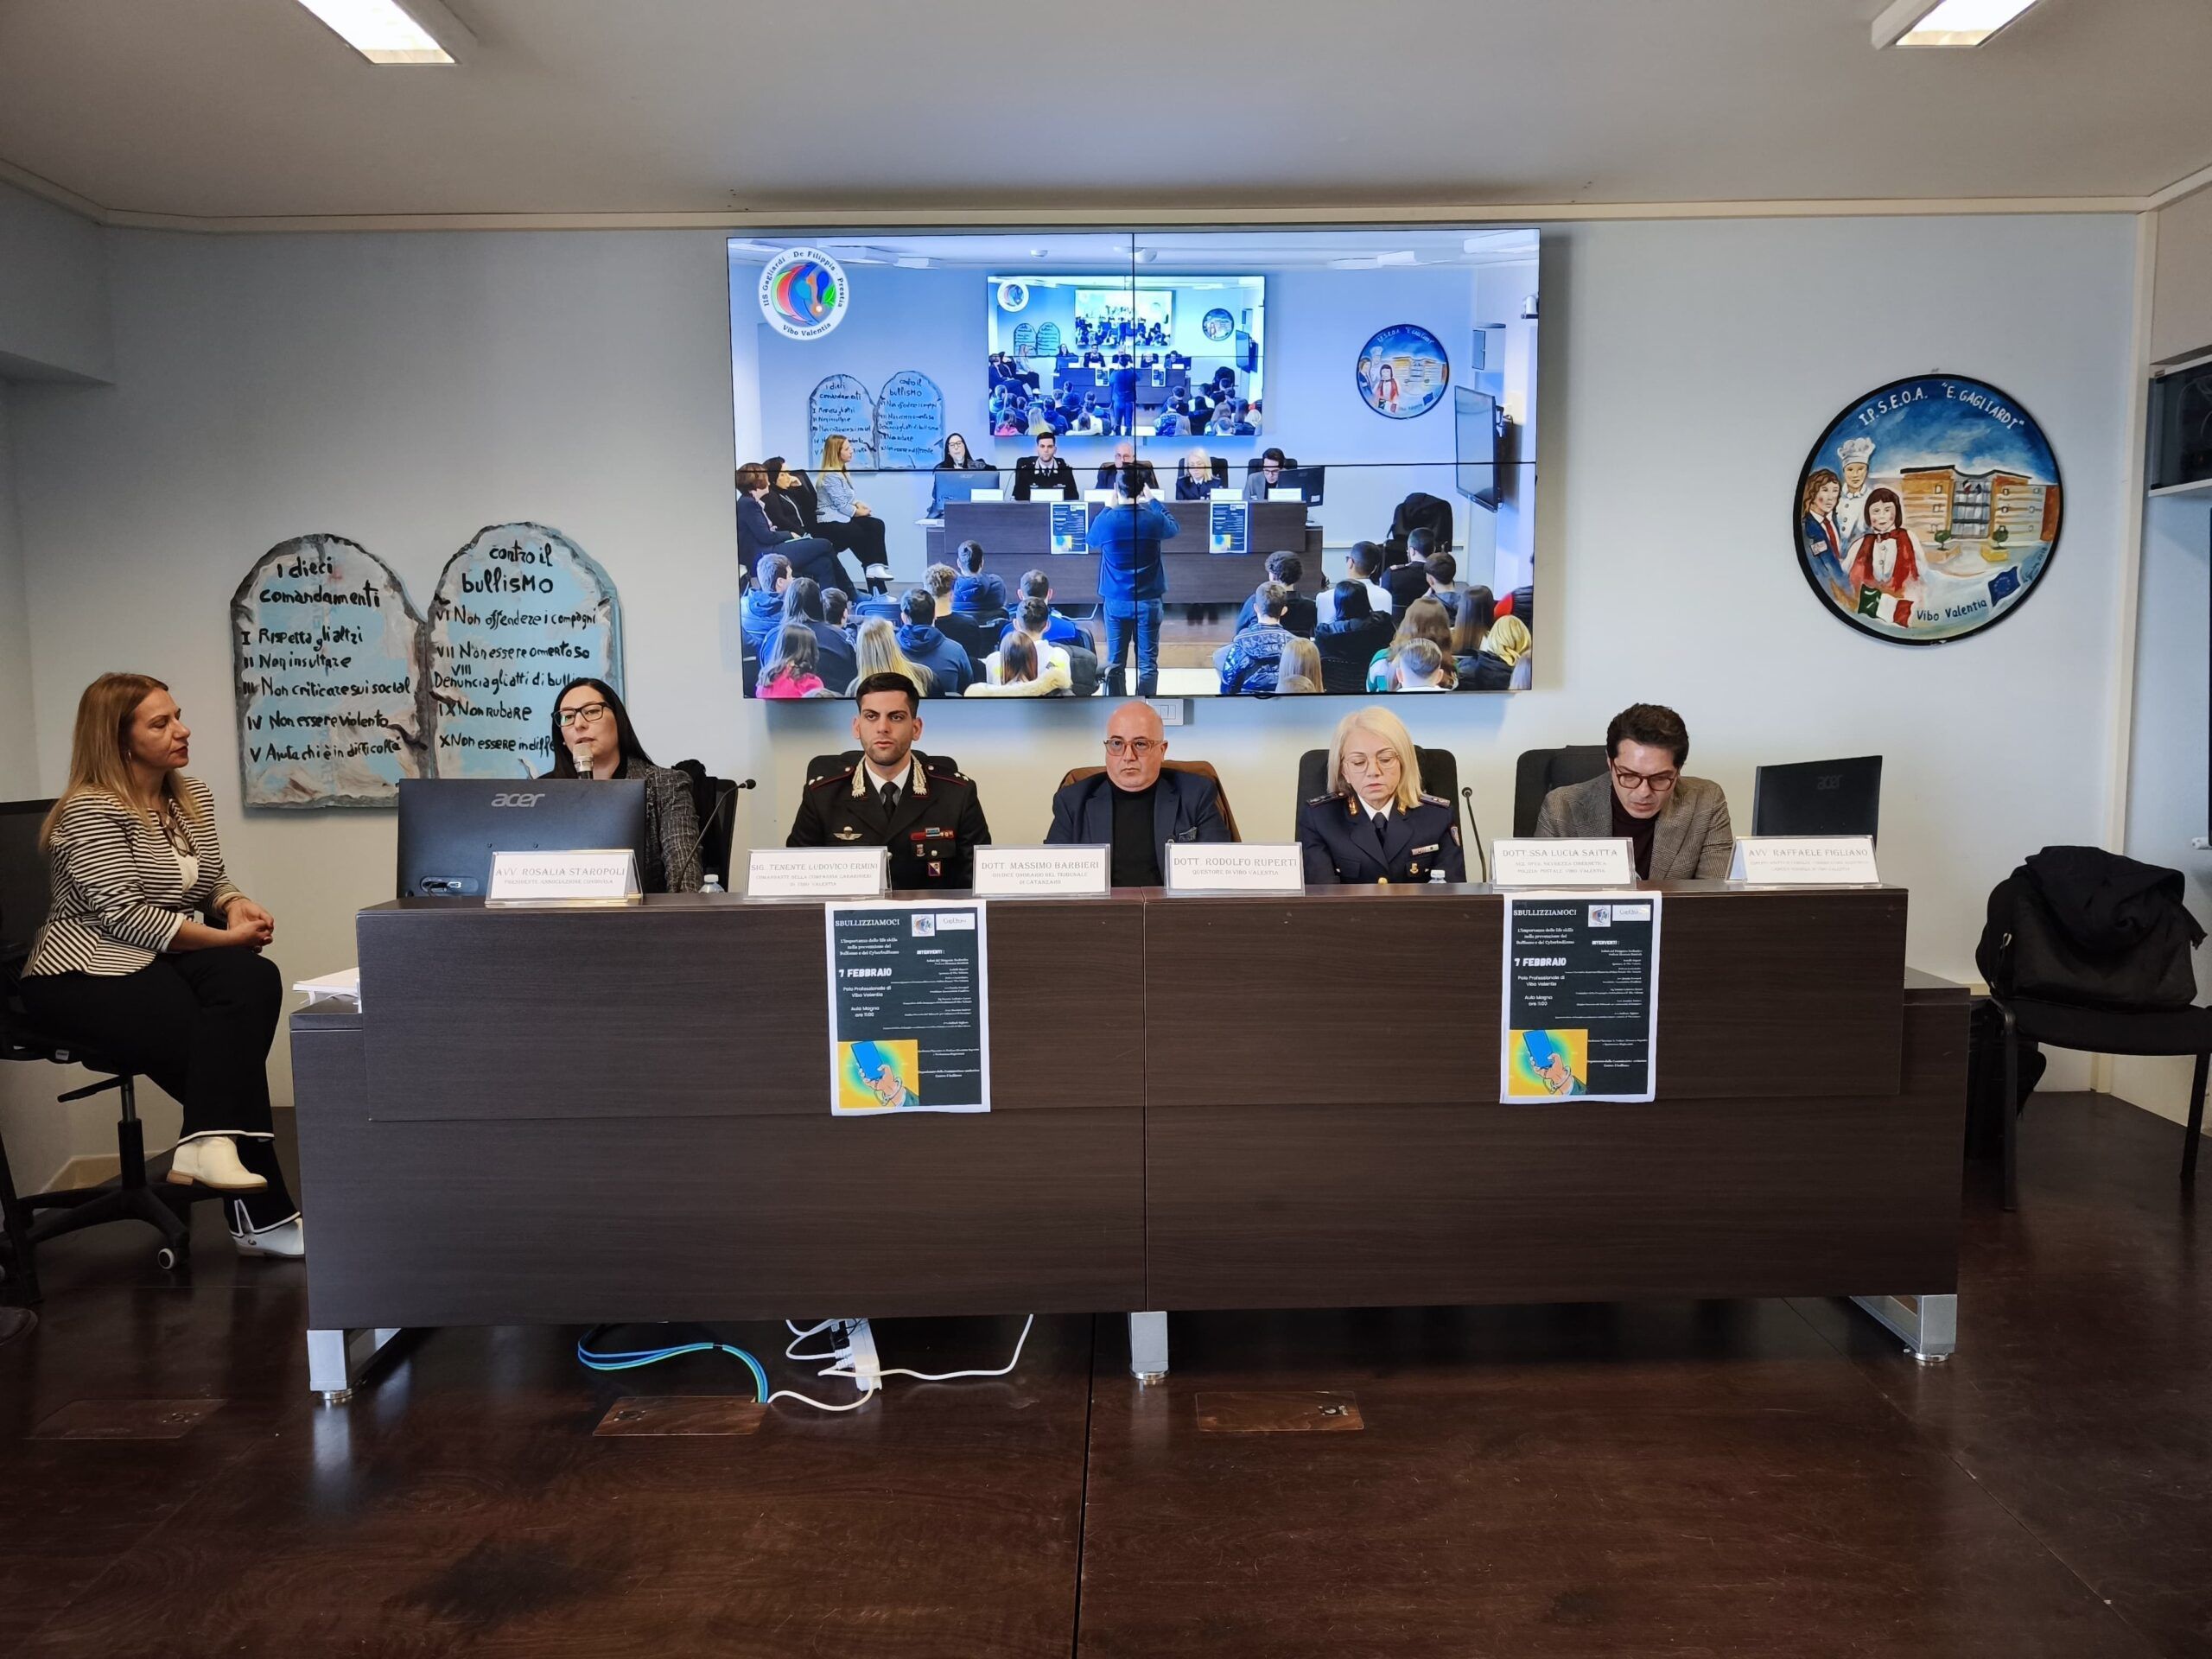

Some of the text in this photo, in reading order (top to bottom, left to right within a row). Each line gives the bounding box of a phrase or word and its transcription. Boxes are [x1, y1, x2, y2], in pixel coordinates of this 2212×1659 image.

[807, 251, 836, 271] Filippis
[762, 256, 785, 290] Gagliardi
[783, 323, 832, 337] Vibo Valentia
[489, 540, 554, 567] contro il
[289, 556, 334, 579] dieci
[259, 580, 380, 607] comandamenti
[1916, 598, 1987, 622] Vibo Valentia
[435, 610, 449, 622] VI
[454, 605, 481, 625] Non
[486, 610, 542, 631] offendere
[551, 608, 597, 630] compagni
[437, 645, 454, 658] VII
[451, 664, 472, 676] VIII
[261, 676, 289, 696] Non
[372, 676, 410, 695] social
[532, 672, 545, 687] di
[548, 671, 577, 687] bulli
[439, 702, 456, 717] IX
[458, 701, 484, 717] Non
[247, 709, 389, 731] IV Non essere violento
[439, 734, 451, 749] X
[451, 732, 475, 747] Non
[518, 735, 555, 758] indiffe
[251, 747, 261, 762] V
[491, 793, 546, 808] acer
[1581, 849, 1618, 857] SAITTA
[1773, 849, 1821, 857] RAFFAELE
[1825, 849, 1868, 857] FIGLIANO
[1054, 861, 1099, 869] BARBIERI
[1205, 857, 1251, 866] RODOLFO
[1255, 858, 1297, 867] RUPERTI
[522, 868, 565, 876] ROSALIA
[569, 868, 625, 876] STAROPOLI
[1514, 957, 1521, 966] 7
[1522, 957, 1567, 967] FEBBRAIO
[838, 969, 845, 978] 7
[847, 968, 892, 978] FEBBRAIO
